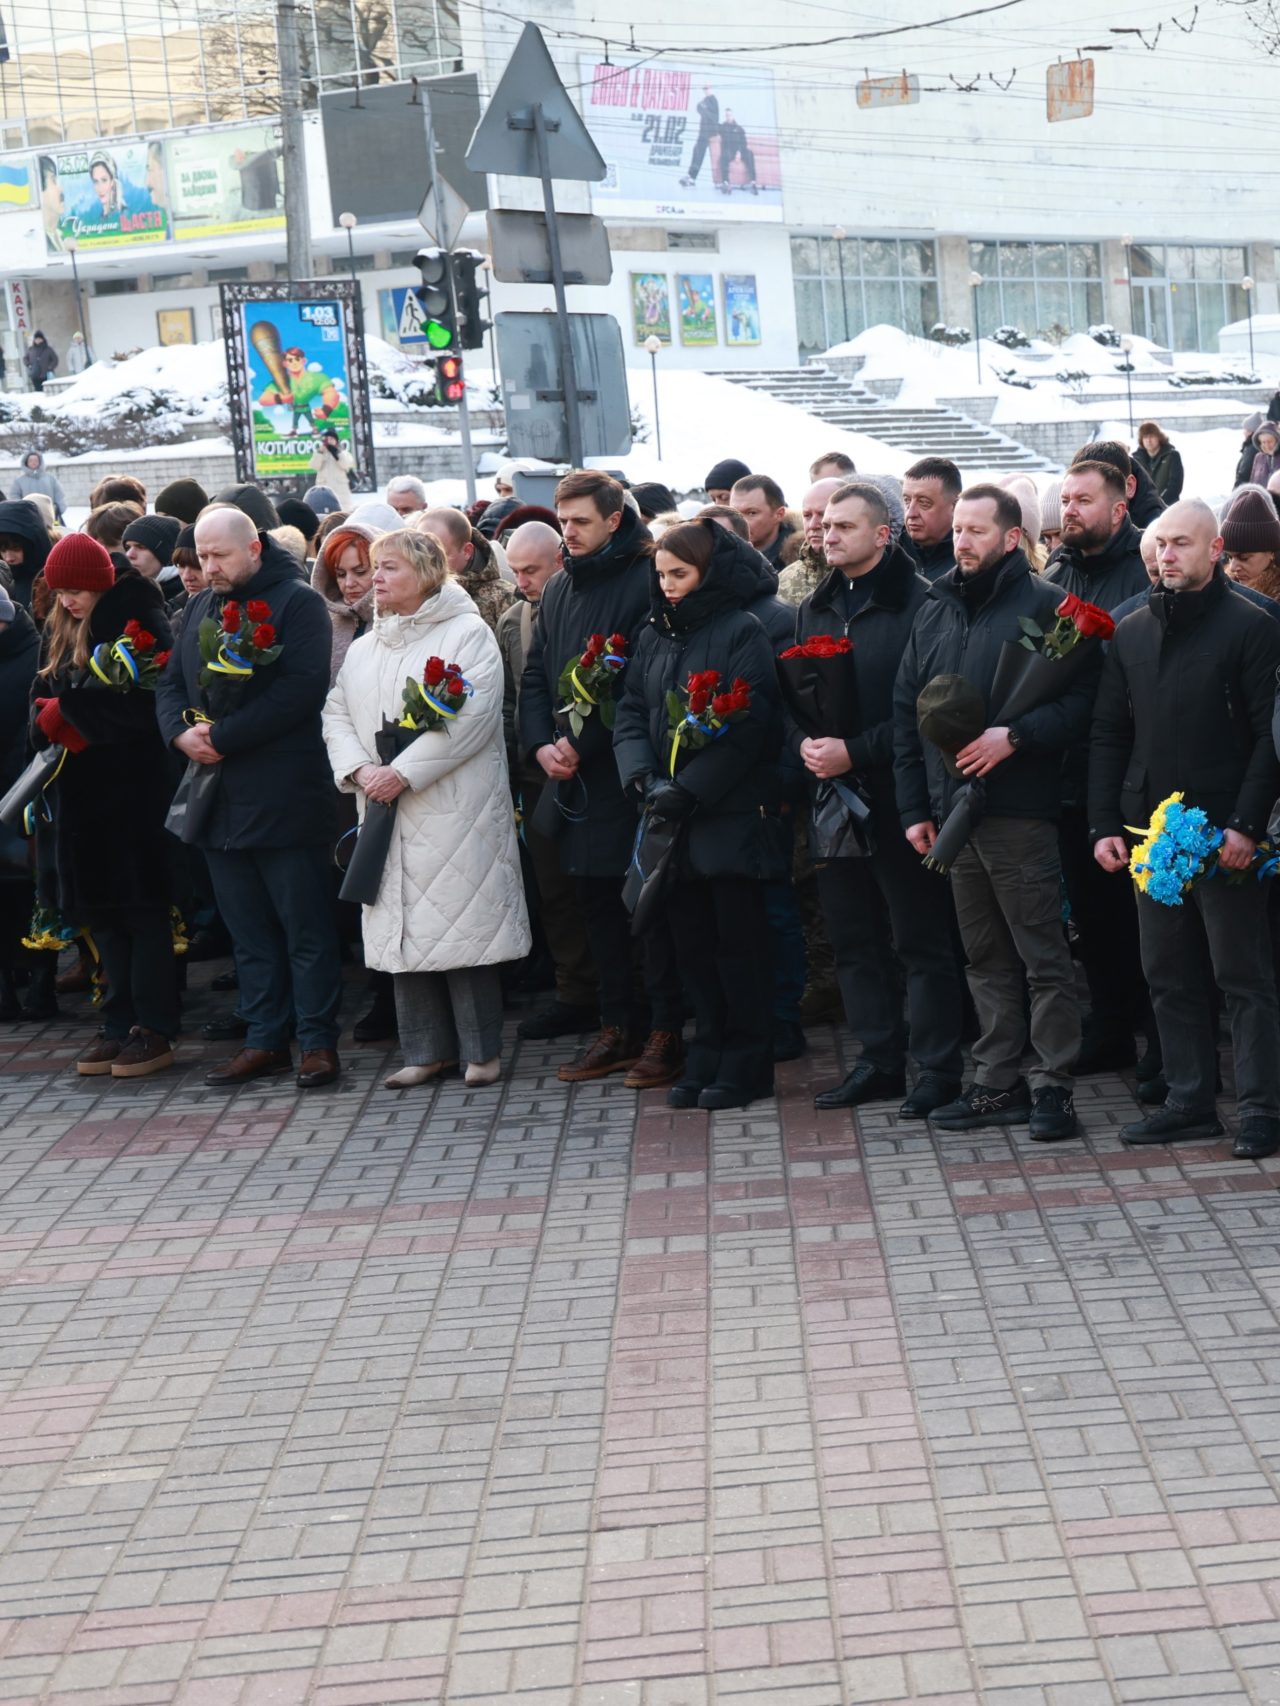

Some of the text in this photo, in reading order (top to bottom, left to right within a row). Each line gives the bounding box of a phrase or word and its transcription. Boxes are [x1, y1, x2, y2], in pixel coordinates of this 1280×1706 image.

[641, 114, 687, 145] 21.02
[119, 211, 162, 233] ЩАСТЯ
[12, 282, 26, 328] КАСА
[302, 306, 334, 320] 1.03
